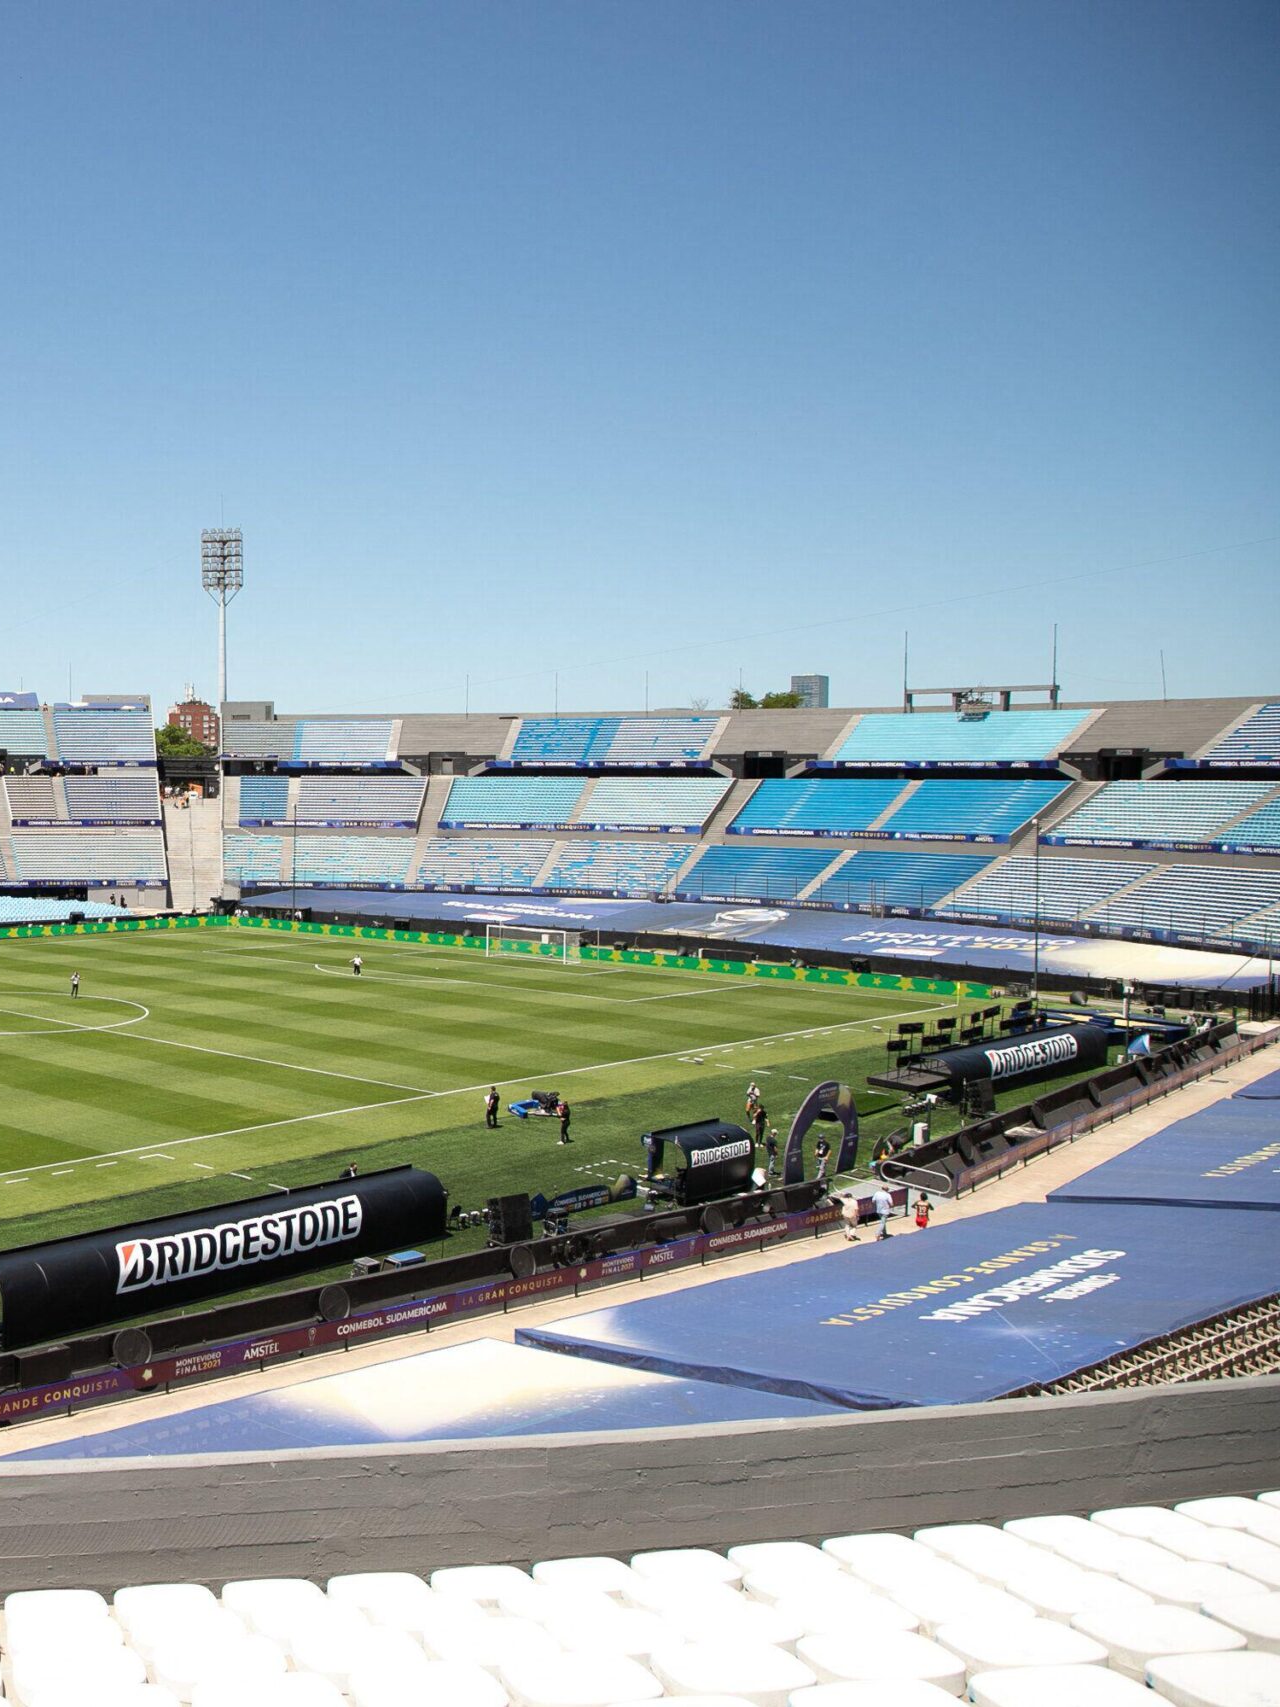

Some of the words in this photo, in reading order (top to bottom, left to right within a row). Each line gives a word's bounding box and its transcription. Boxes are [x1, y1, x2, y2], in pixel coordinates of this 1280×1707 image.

[860, 930, 1076, 946] MONTEVIDEO
[986, 1035, 1077, 1079] BRIDGESTONE
[693, 1141, 750, 1167] BRIDGESTONE
[805, 1212, 834, 1225] GRANDE
[119, 1198, 360, 1291] BRIDGESTONE
[709, 1232, 742, 1248] CONMEBOL
[743, 1222, 788, 1239] SUDAMERICANA
[602, 1255, 635, 1268] MONTEVIDEO
[649, 1251, 674, 1265] AMSTEL
[963, 1240, 1062, 1275] GRANDE
[462, 1294, 474, 1306] LA
[478, 1288, 505, 1302] GRAN
[509, 1274, 564, 1295] CONQUISTA
[918, 1248, 1127, 1322] SUDAMERICANA
[819, 1274, 974, 1327] CONQUISTA
[337, 1317, 384, 1336] CONMEBOL
[385, 1301, 448, 1325] SUDAMERICANA
[175, 1351, 222, 1368] MONTEVIDEO
[243, 1341, 280, 1361] AMSTEL
[44, 1378, 119, 1404] CONQUISTA
